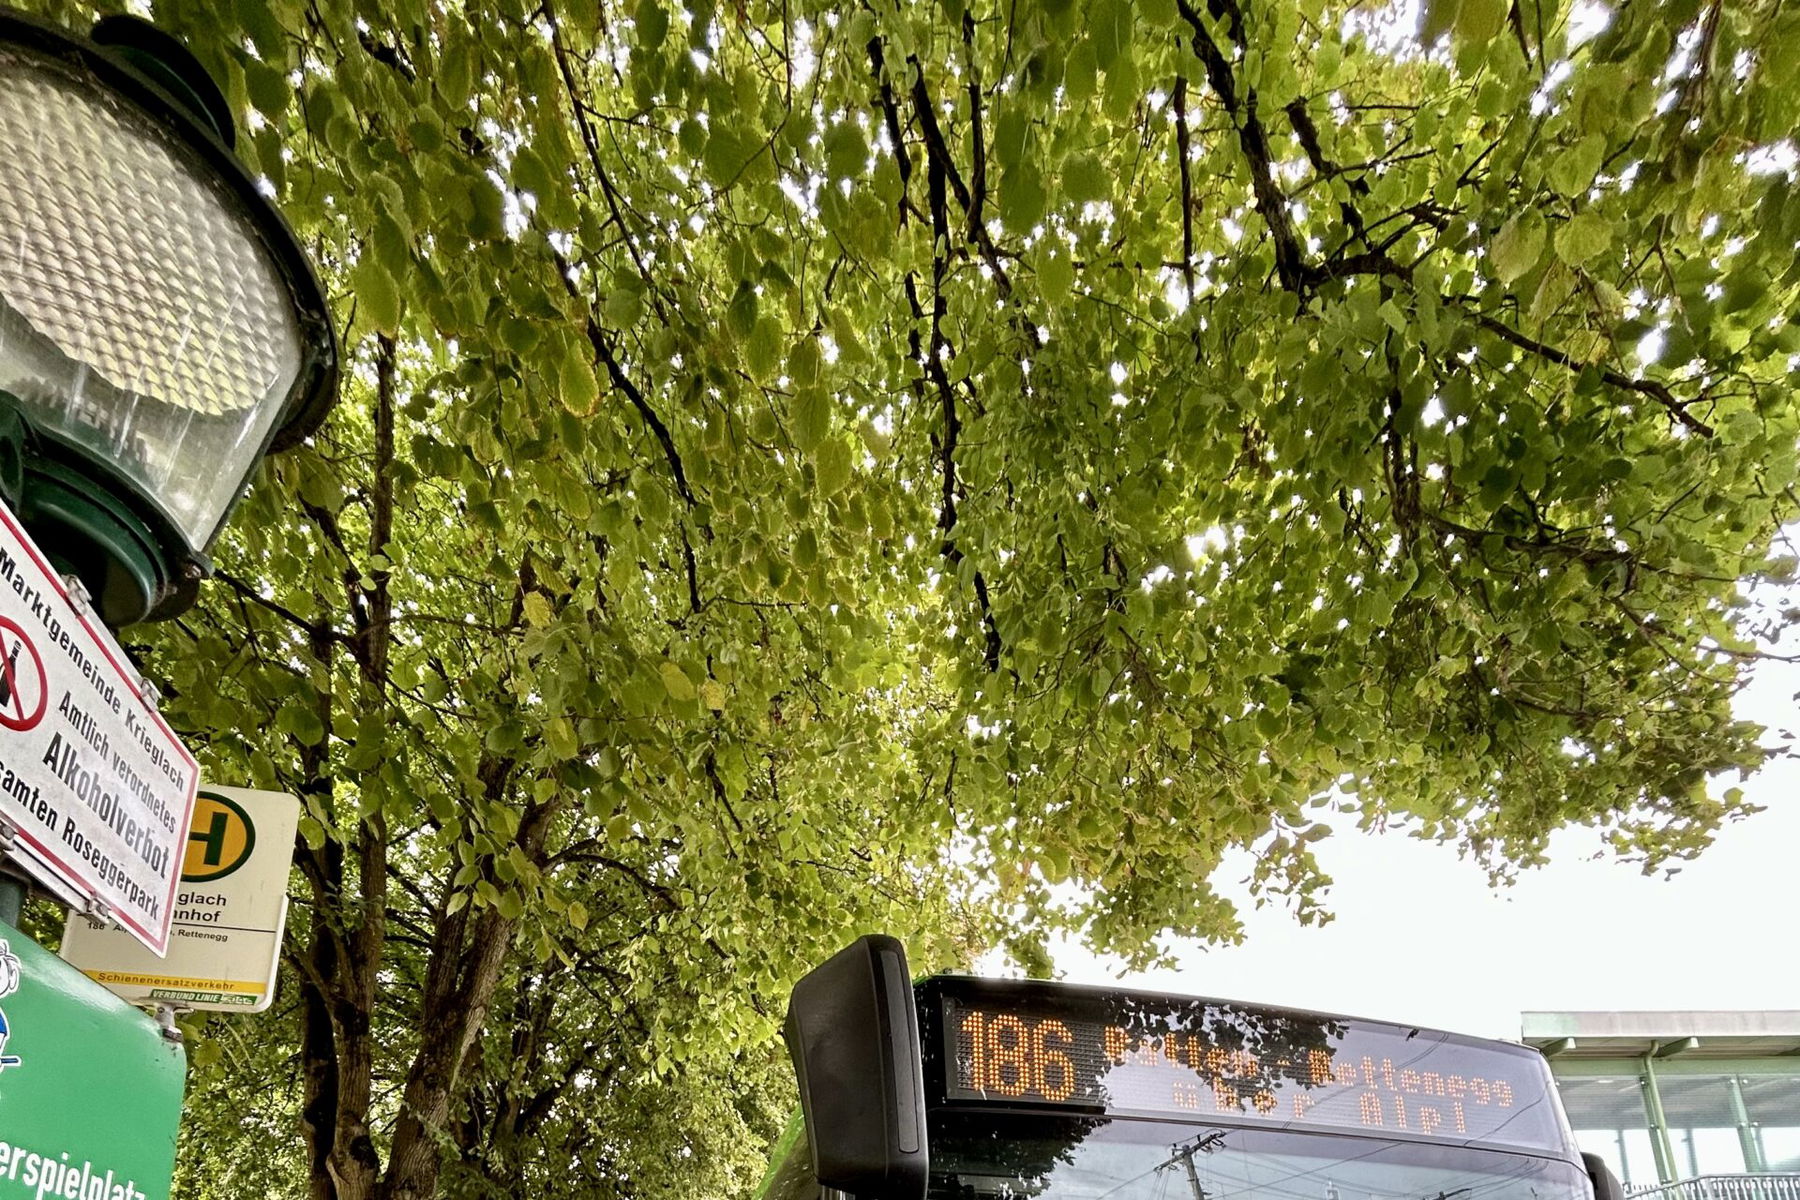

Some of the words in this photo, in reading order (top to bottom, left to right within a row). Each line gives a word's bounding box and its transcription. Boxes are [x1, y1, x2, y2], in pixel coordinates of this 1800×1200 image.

[0, 547, 121, 715] Marktgemeinde
[125, 708, 184, 791] Krieglach
[42, 731, 170, 880] Alkoholverbot
[59, 691, 109, 760] Amtlich
[112, 752, 176, 833] verordnetes
[62, 816, 159, 920] Roseggerpark
[178, 929, 229, 943] Rettenegg
[98, 972, 235, 991] Schienenersatzverkehr
[152, 990, 195, 1001] VERBUND
[195, 993, 220, 1002] LINIE
[962, 1011, 1075, 1101] 186
[1308, 1049, 1514, 1107] Rettenegg
